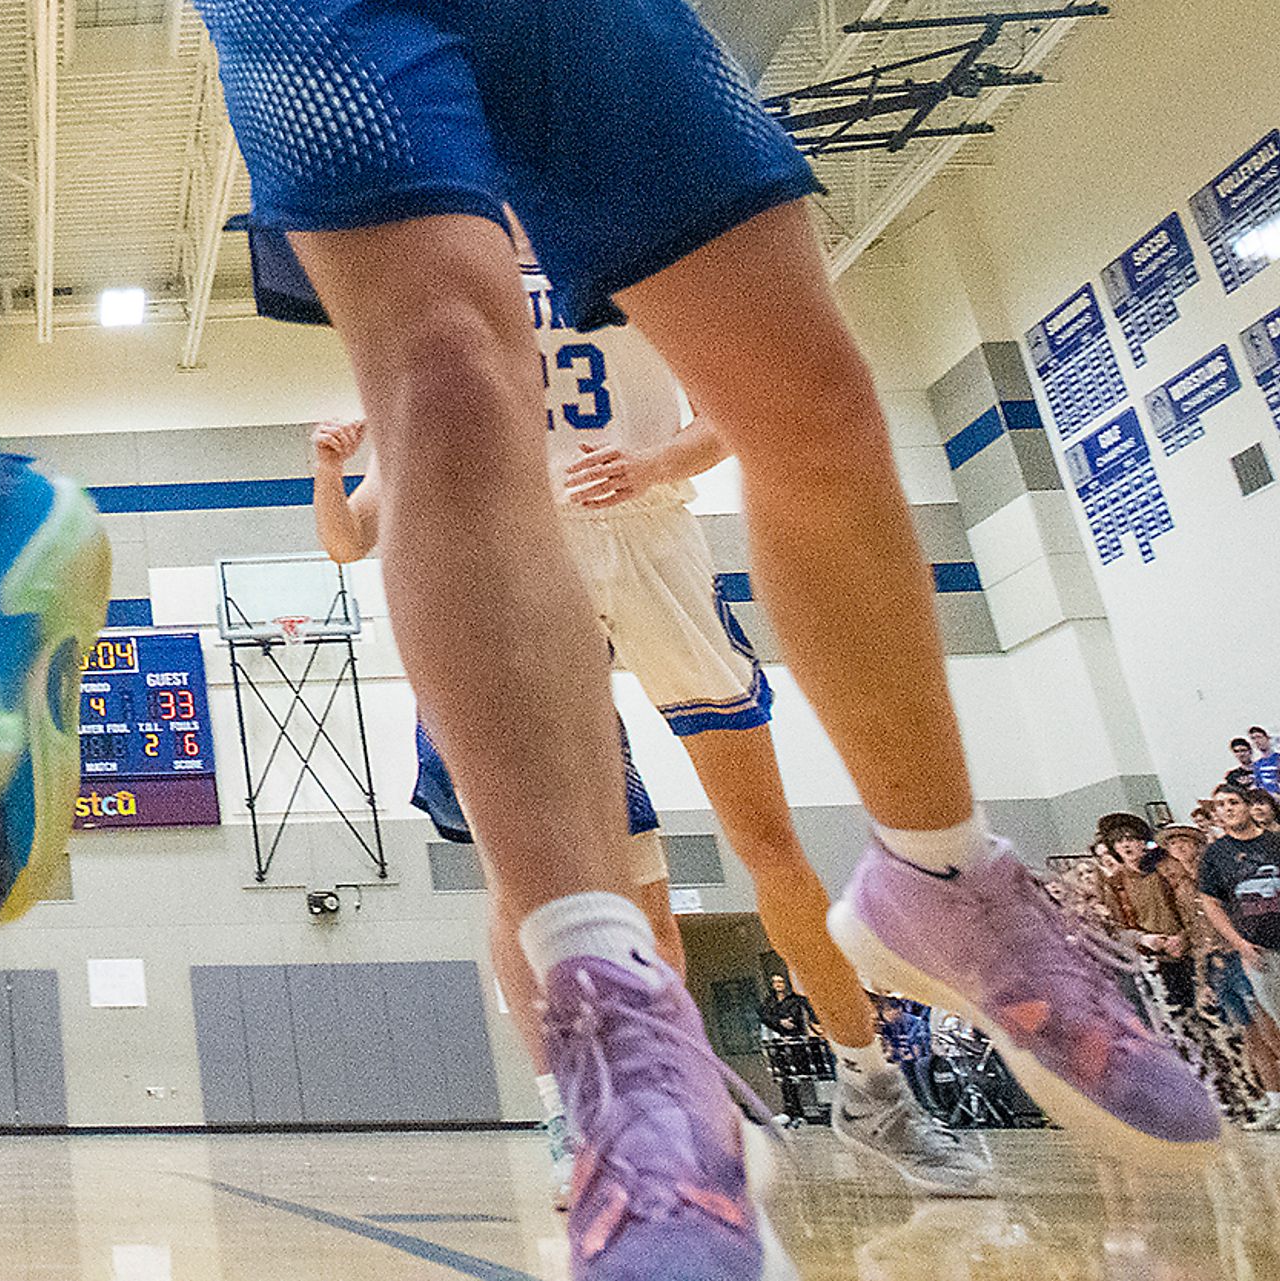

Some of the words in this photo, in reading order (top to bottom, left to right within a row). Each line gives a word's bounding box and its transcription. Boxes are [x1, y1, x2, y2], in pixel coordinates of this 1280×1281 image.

[540, 341, 612, 430] 3
[146, 672, 191, 687] GUEST
[90, 697, 106, 717] 4
[158, 690, 196, 720] 33
[144, 733, 160, 757] 2
[183, 733, 200, 757] 6
[75, 790, 138, 817] stcu
